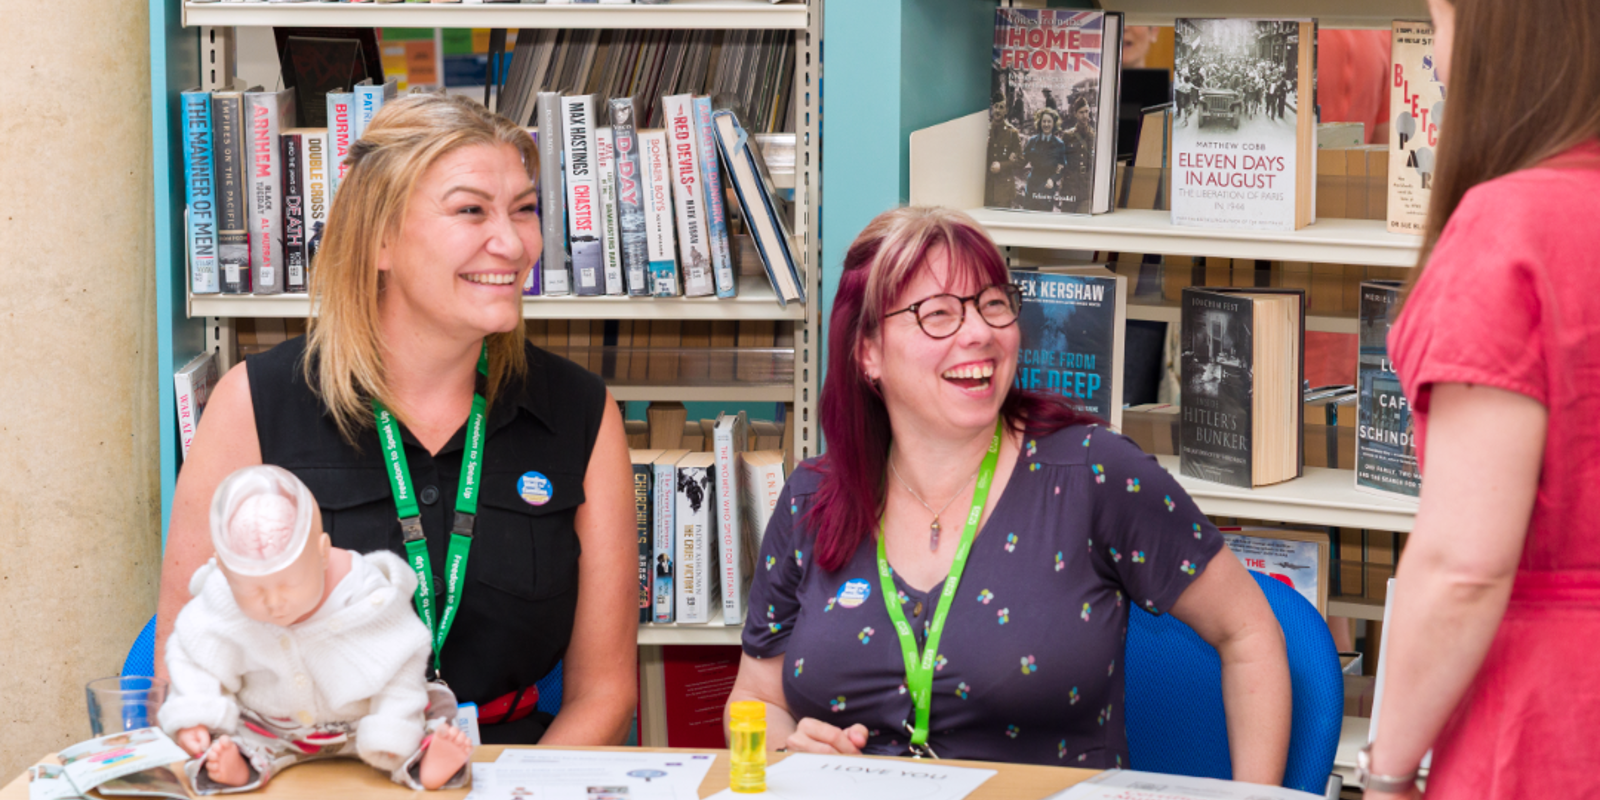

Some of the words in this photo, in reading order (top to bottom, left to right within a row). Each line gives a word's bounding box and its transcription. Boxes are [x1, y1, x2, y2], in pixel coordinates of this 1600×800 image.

[1008, 28, 1080, 49] HOME
[1001, 49, 1085, 72] FRONT
[188, 99, 207, 129] THE
[222, 100, 230, 145] EMPIRES
[569, 102, 585, 125] MAX
[699, 104, 710, 123] AIR
[335, 104, 349, 156] BURMA
[674, 116, 689, 140] RED
[254, 104, 271, 178] ARNHEM
[570, 127, 588, 176] HASTINGS
[598, 138, 606, 167] ARTHUR
[702, 126, 716, 170] BATTLE
[1196, 141, 1238, 150] MATTHEW
[189, 132, 211, 197] MANNER
[225, 150, 232, 162] ON
[308, 138, 323, 180] DOUBLE
[651, 139, 662, 182] BOMBER
[677, 144, 695, 185] DEVILS
[1179, 152, 1236, 170] ELEVEN
[1243, 155, 1285, 171] DAYS
[1399, 132, 1432, 190] PAR
[616, 137, 637, 205] D-DAY
[1186, 171, 1202, 186] IN
[1206, 172, 1276, 188] AUGUST
[256, 182, 264, 215] TUESDAY
[310, 183, 324, 219] CROSS
[655, 185, 665, 211] BOYS
[708, 172, 724, 223] DUNKIRK
[1179, 188, 1193, 197] THE
[1196, 190, 1244, 200] LIBERATION
[1247, 191, 1258, 200] OF
[1261, 192, 1284, 201] PARIS
[193, 201, 211, 219] OF
[226, 192, 235, 229] PACIFIC
[574, 185, 592, 231] CHASTISE
[686, 200, 696, 219] MARK
[261, 218, 270, 230] AL
[286, 196, 302, 246] DEATH
[606, 204, 614, 250] DAMBUSTERS
[194, 223, 214, 255] MEN
[262, 232, 271, 267] MURRAY
[1041, 281, 1104, 301] KERSHAW
[1365, 293, 1391, 304] MERIEL
[1192, 298, 1221, 309] JOACHIM
[1223, 302, 1238, 312] FEST
[1017, 349, 1057, 366] SCAPE
[1059, 352, 1095, 370] FROM
[1047, 370, 1101, 399] DEEP
[180, 394, 190, 418] WAR
[1184, 406, 1237, 430] HITLER'S
[183, 422, 192, 433] AT
[381, 410, 390, 427] Up
[385, 427, 396, 450] Speak
[471, 413, 483, 449] Freedom
[1196, 427, 1248, 451] BUNKER
[1360, 425, 1416, 447] SCHINDL
[391, 450, 399, 461] to
[471, 450, 477, 460] to
[393, 461, 407, 499] Freedom
[467, 461, 477, 487] Speak
[722, 463, 730, 497] WOMEN
[463, 487, 472, 499] Up
[723, 500, 731, 521] WHO
[684, 525, 693, 537] THE
[684, 540, 694, 561] CRUEL
[415, 556, 424, 570] Up
[449, 554, 462, 593] Freedom
[1245, 558, 1265, 568] THE
[684, 563, 694, 594] VICTORY
[902, 771, 947, 779] YOU
